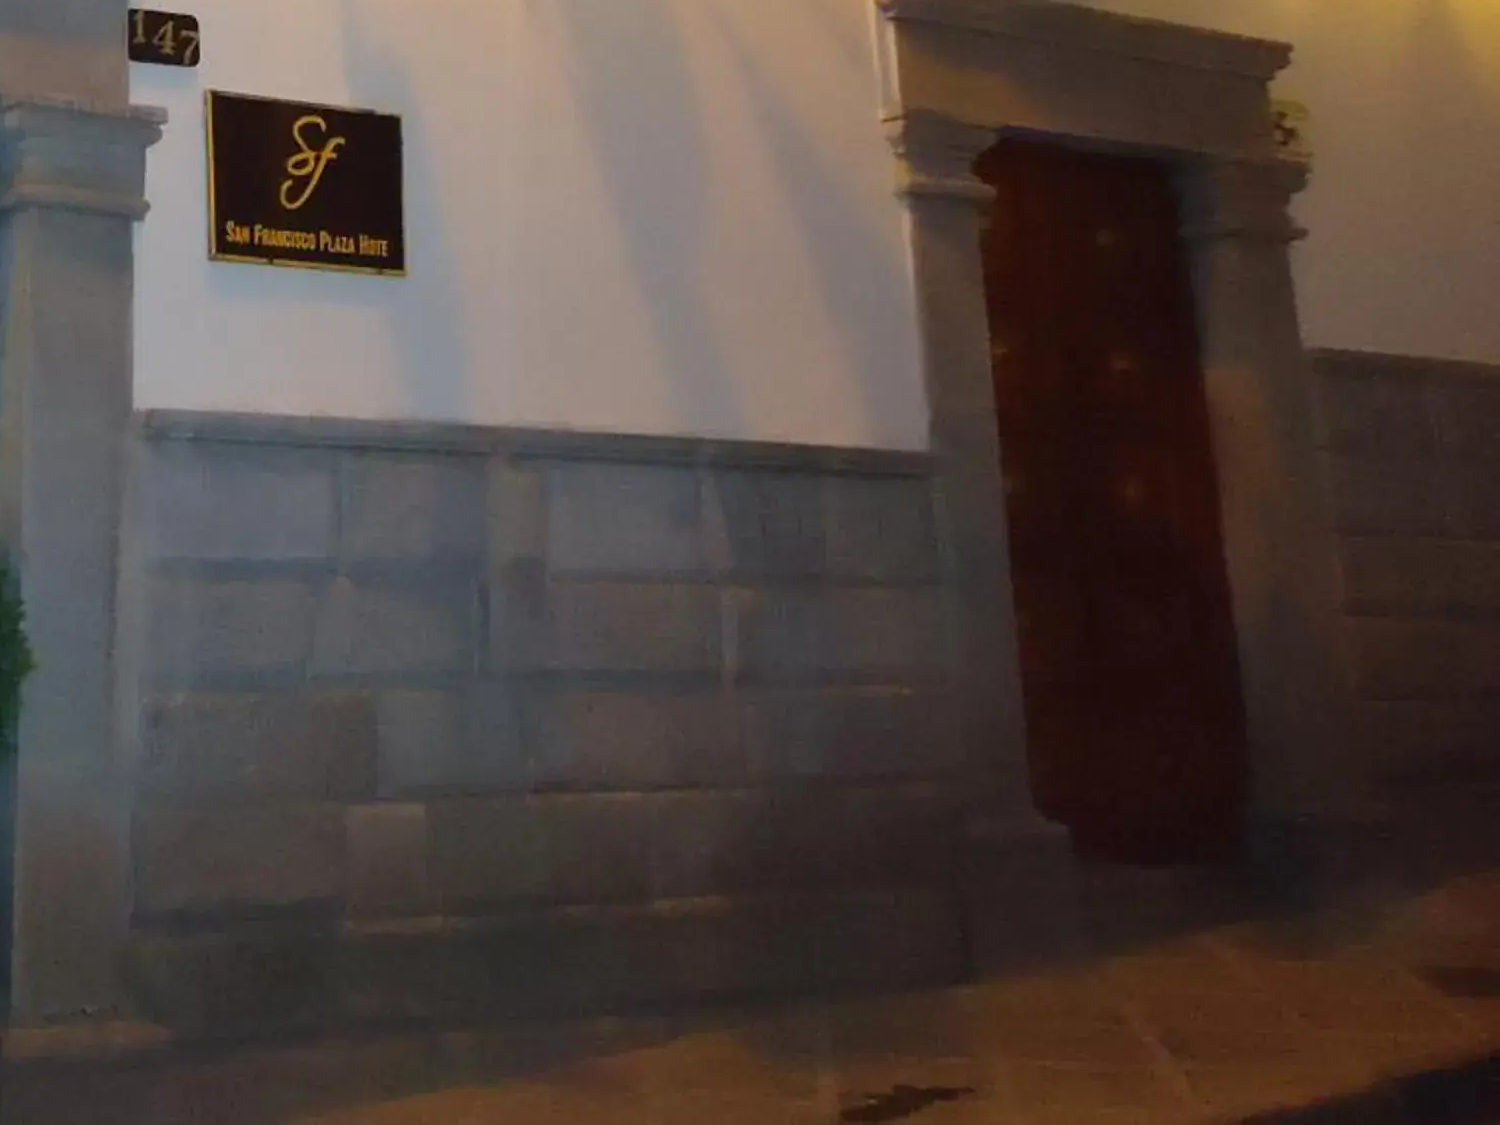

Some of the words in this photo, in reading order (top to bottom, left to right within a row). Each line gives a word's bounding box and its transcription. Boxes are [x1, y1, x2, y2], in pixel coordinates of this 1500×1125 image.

[132, 10, 199, 65] 147
[226, 220, 250, 244] SAN
[254, 223, 316, 251] FRANCISCO
[319, 230, 356, 255] PLAZA
